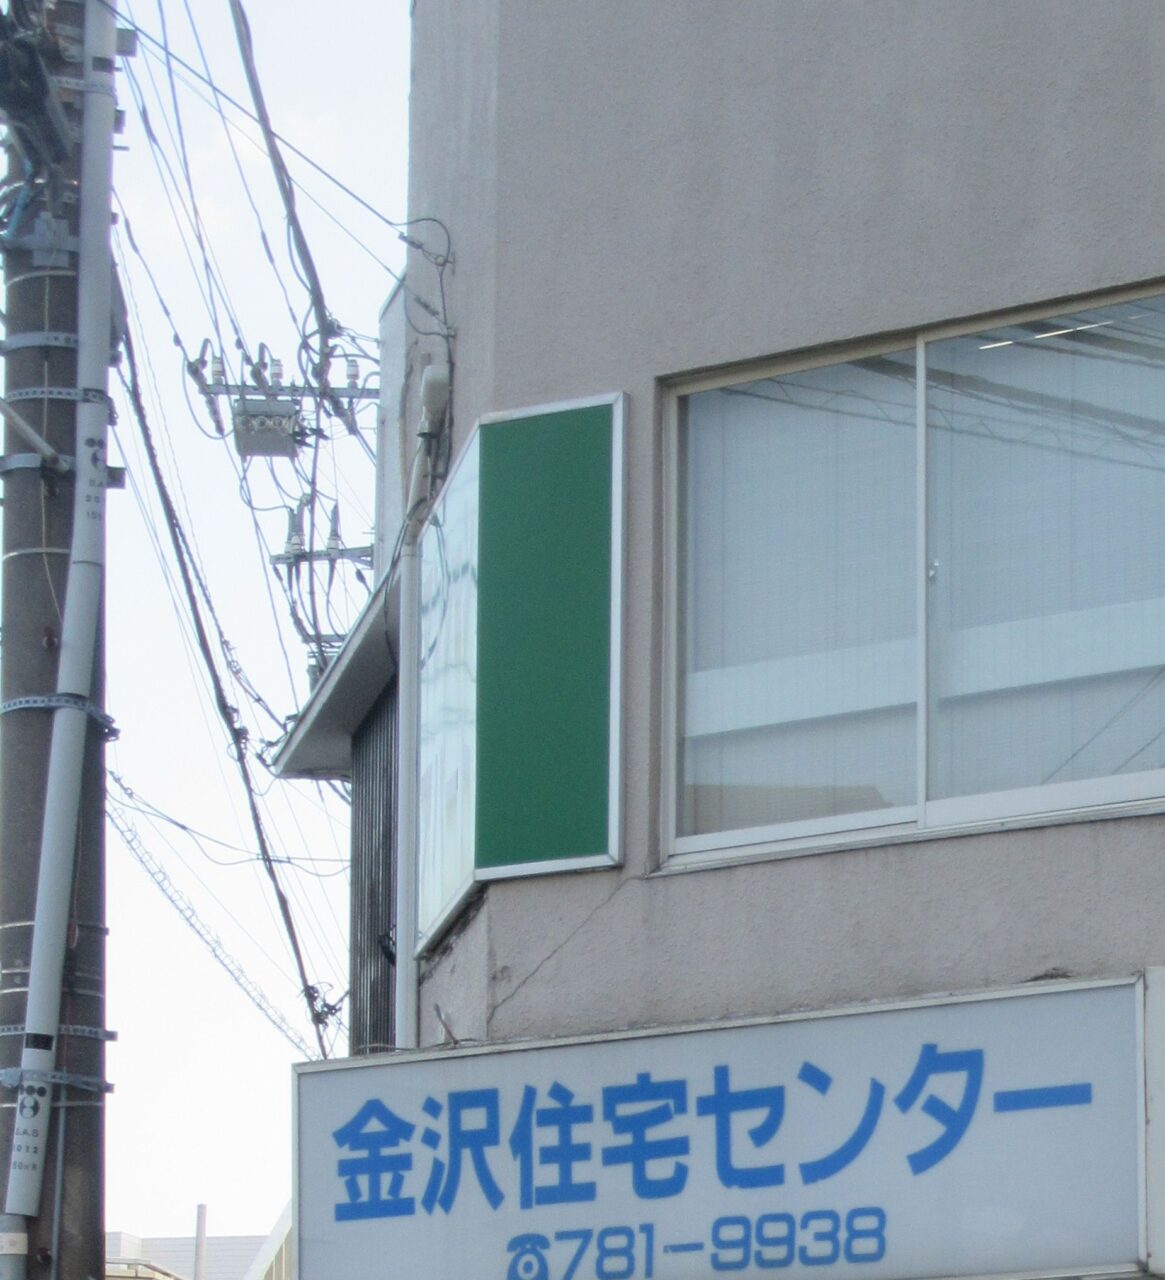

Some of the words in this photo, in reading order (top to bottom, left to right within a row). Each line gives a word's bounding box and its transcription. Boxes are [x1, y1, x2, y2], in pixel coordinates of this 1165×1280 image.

[331, 1042, 1092, 1221] 金沢住宅センター
